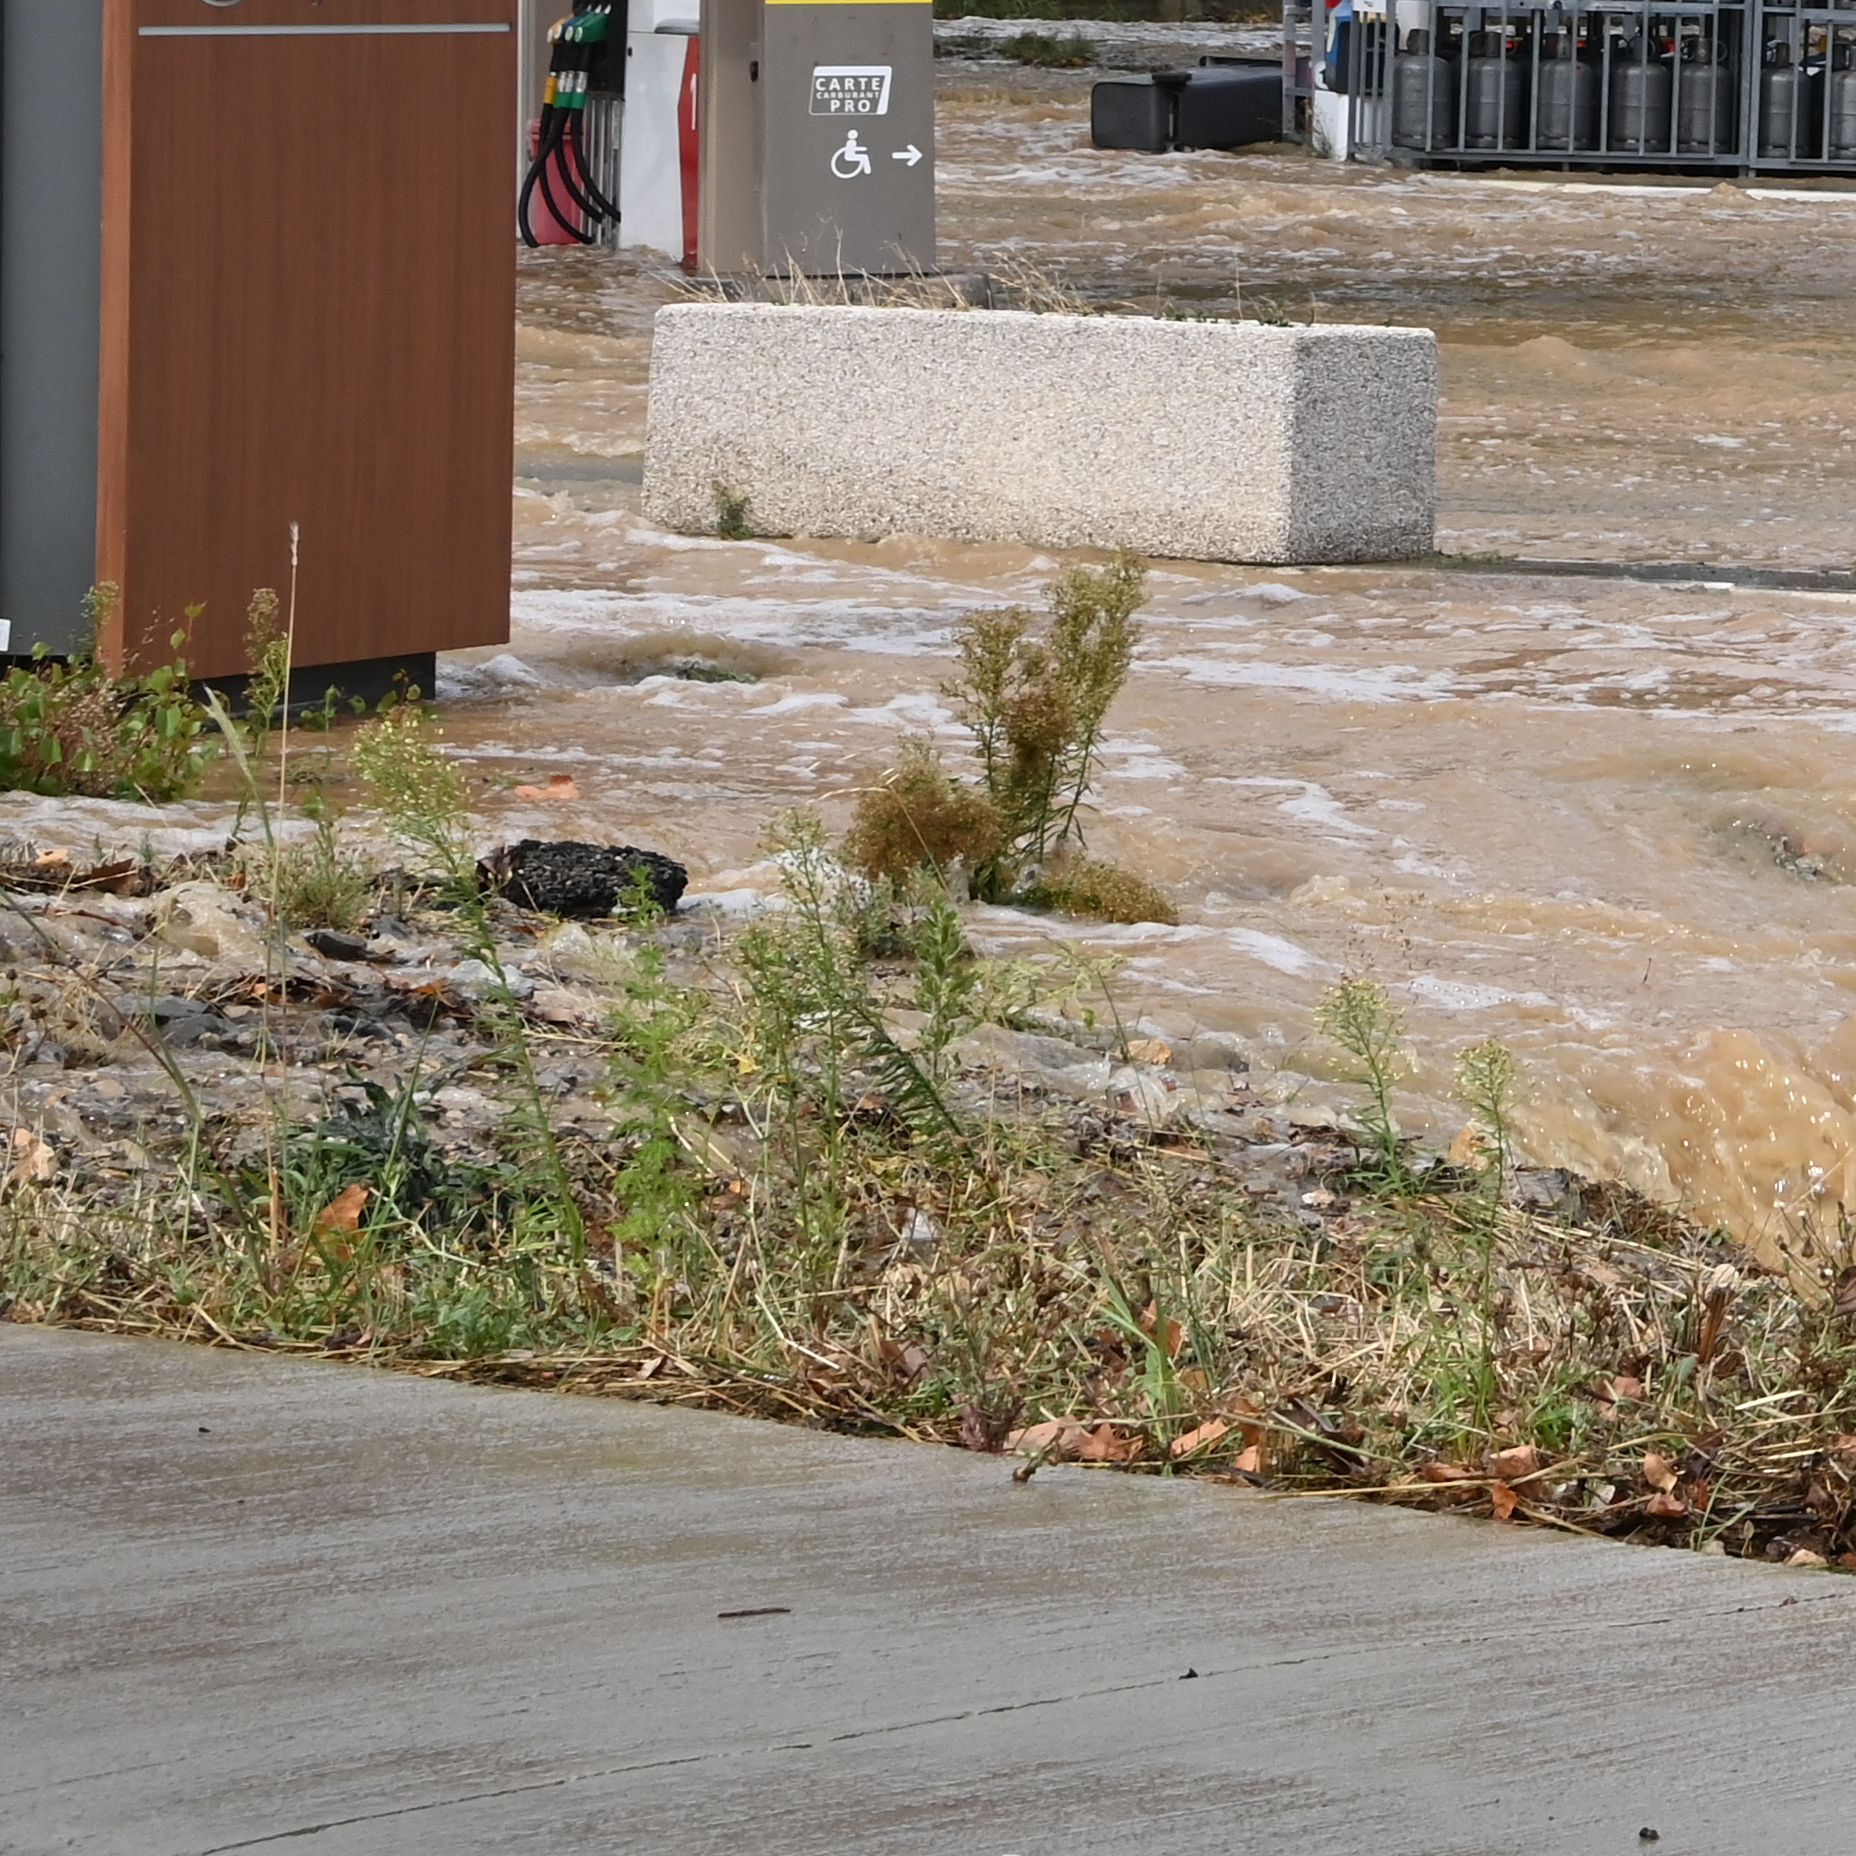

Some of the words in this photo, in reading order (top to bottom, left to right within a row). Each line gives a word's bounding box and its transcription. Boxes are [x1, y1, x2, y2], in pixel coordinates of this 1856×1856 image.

[815, 78, 880, 90] CARTE
[816, 91, 879, 99] CARBURANT
[830, 100, 871, 112] PRO
